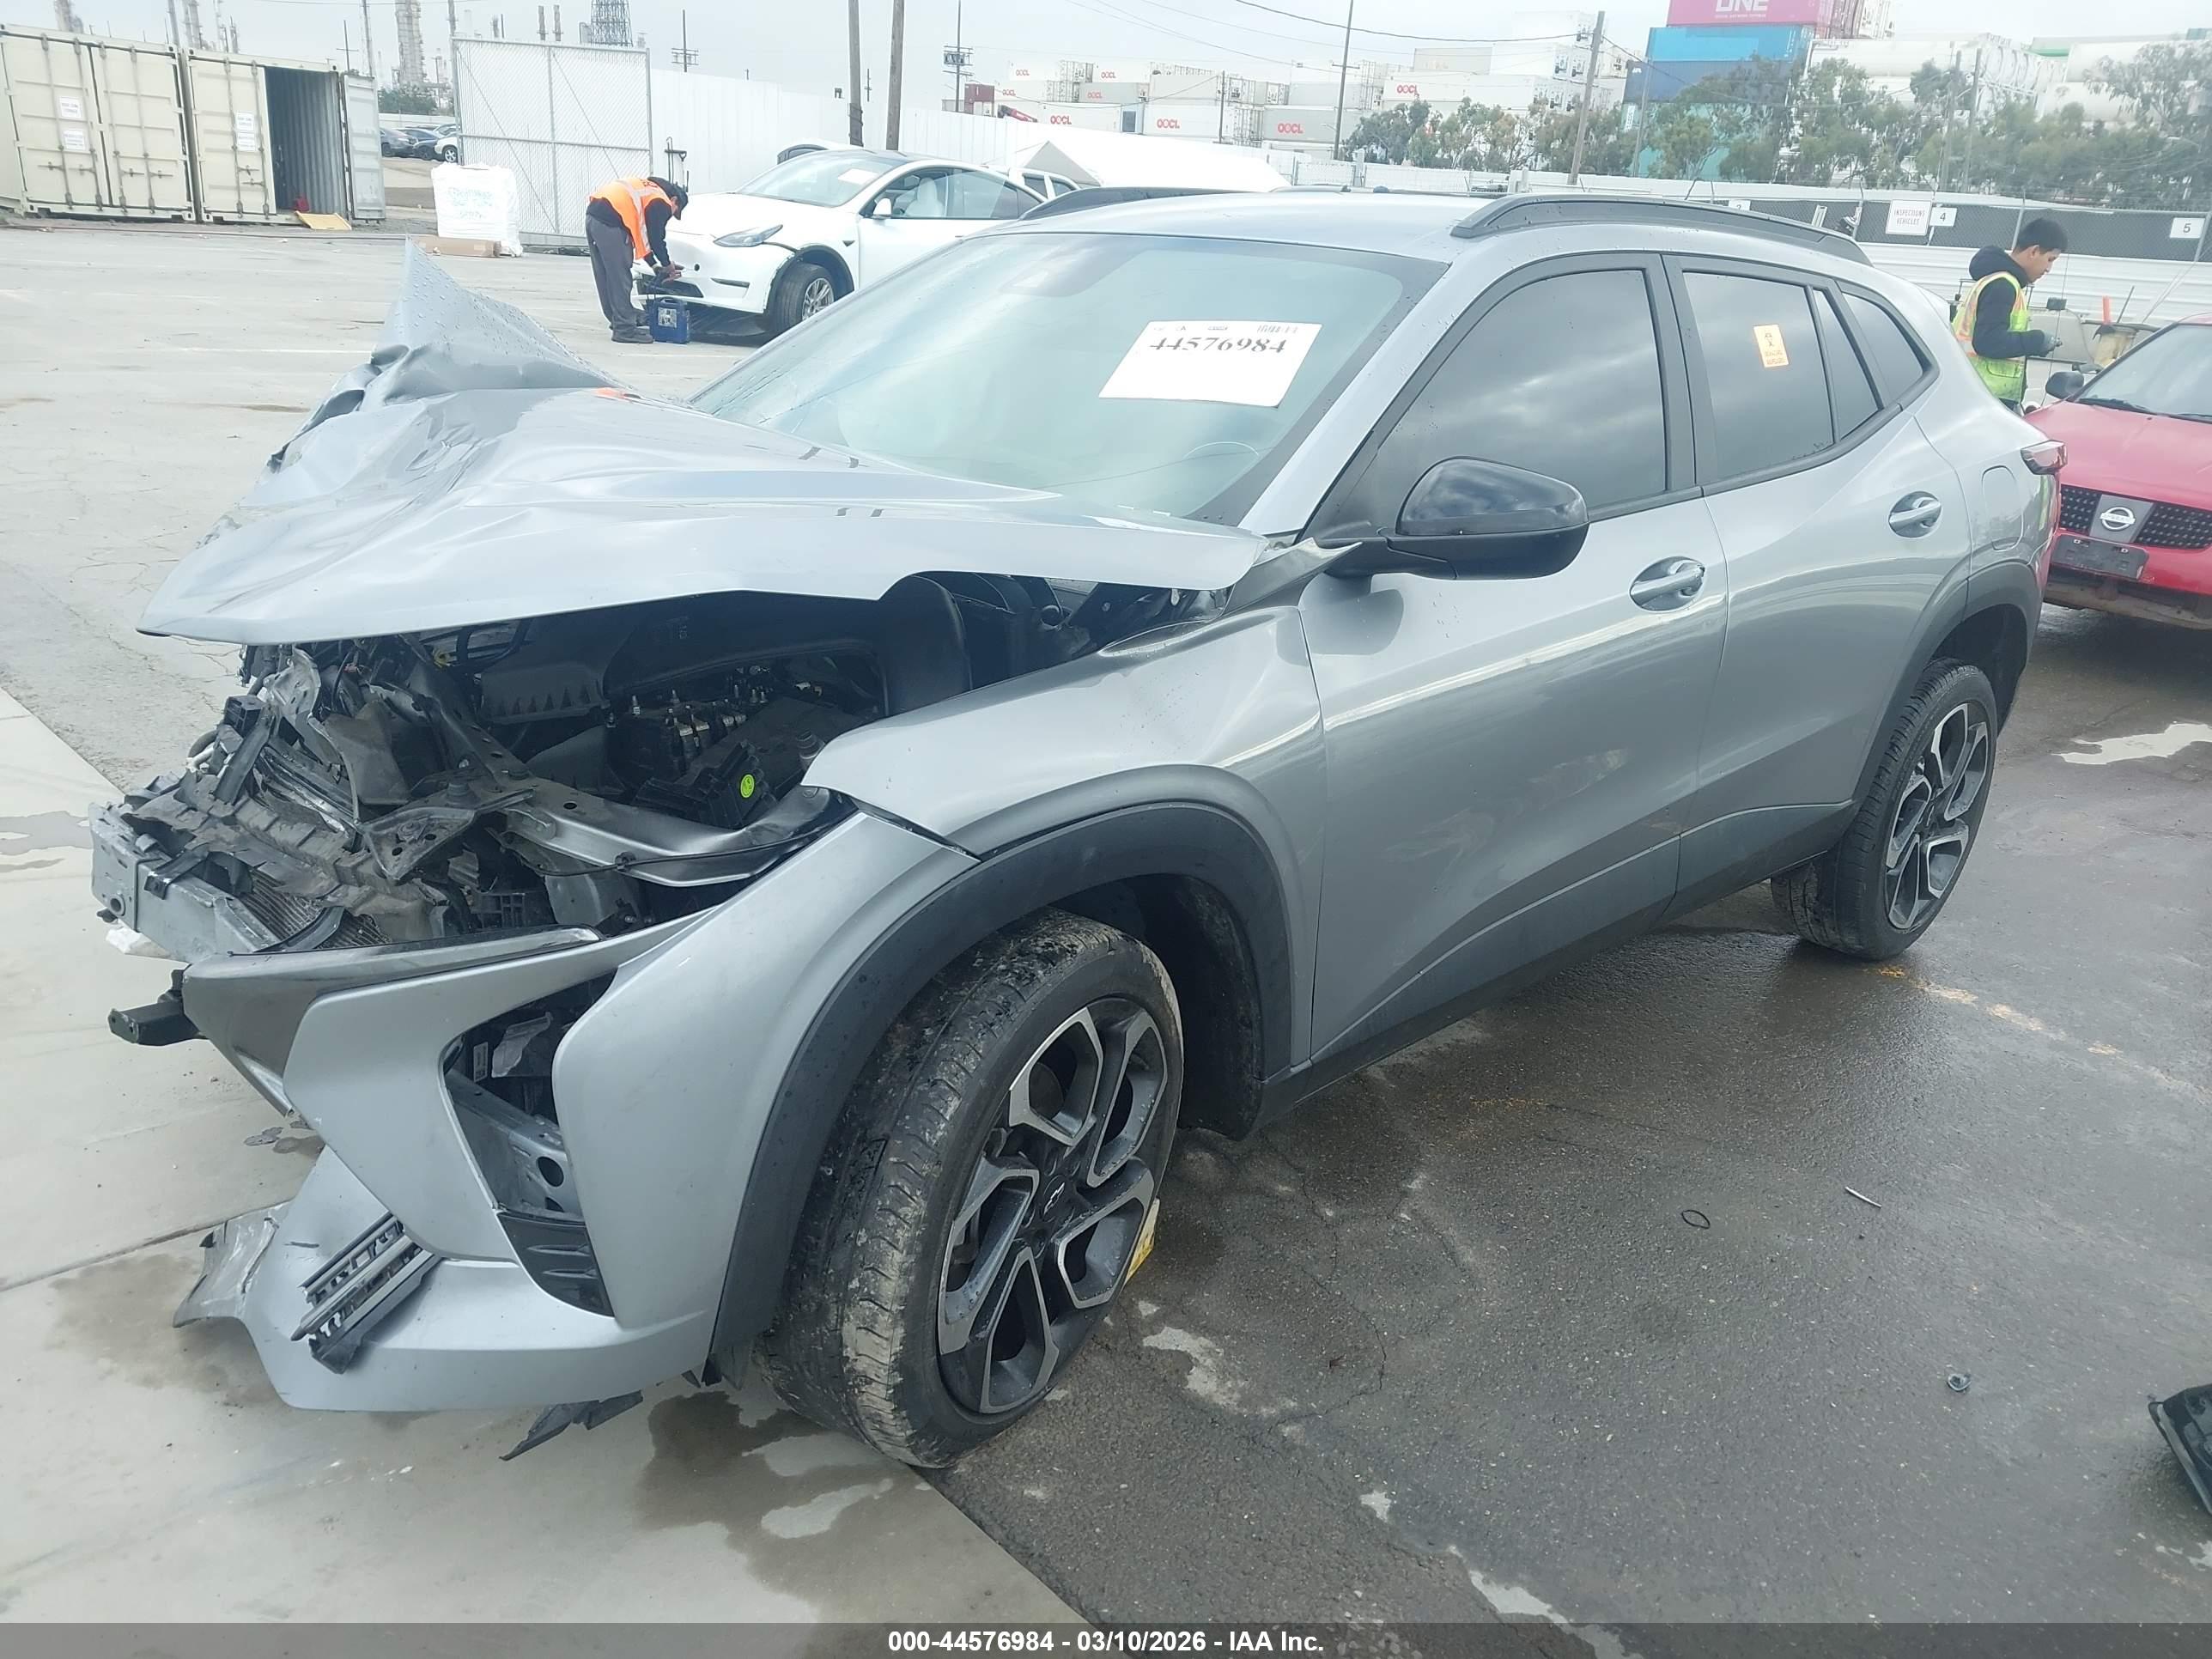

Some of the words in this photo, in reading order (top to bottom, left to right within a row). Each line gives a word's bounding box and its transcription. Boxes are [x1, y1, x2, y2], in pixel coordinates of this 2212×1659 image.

[1050, 115, 1072, 125] OOCL
[1157, 118, 1180, 129] OOCL
[1277, 123, 1303, 133] OOCL
[1940, 212, 1946, 222] 4
[2183, 222, 2191, 234] 5
[1150, 337, 1286, 353] 44576984
